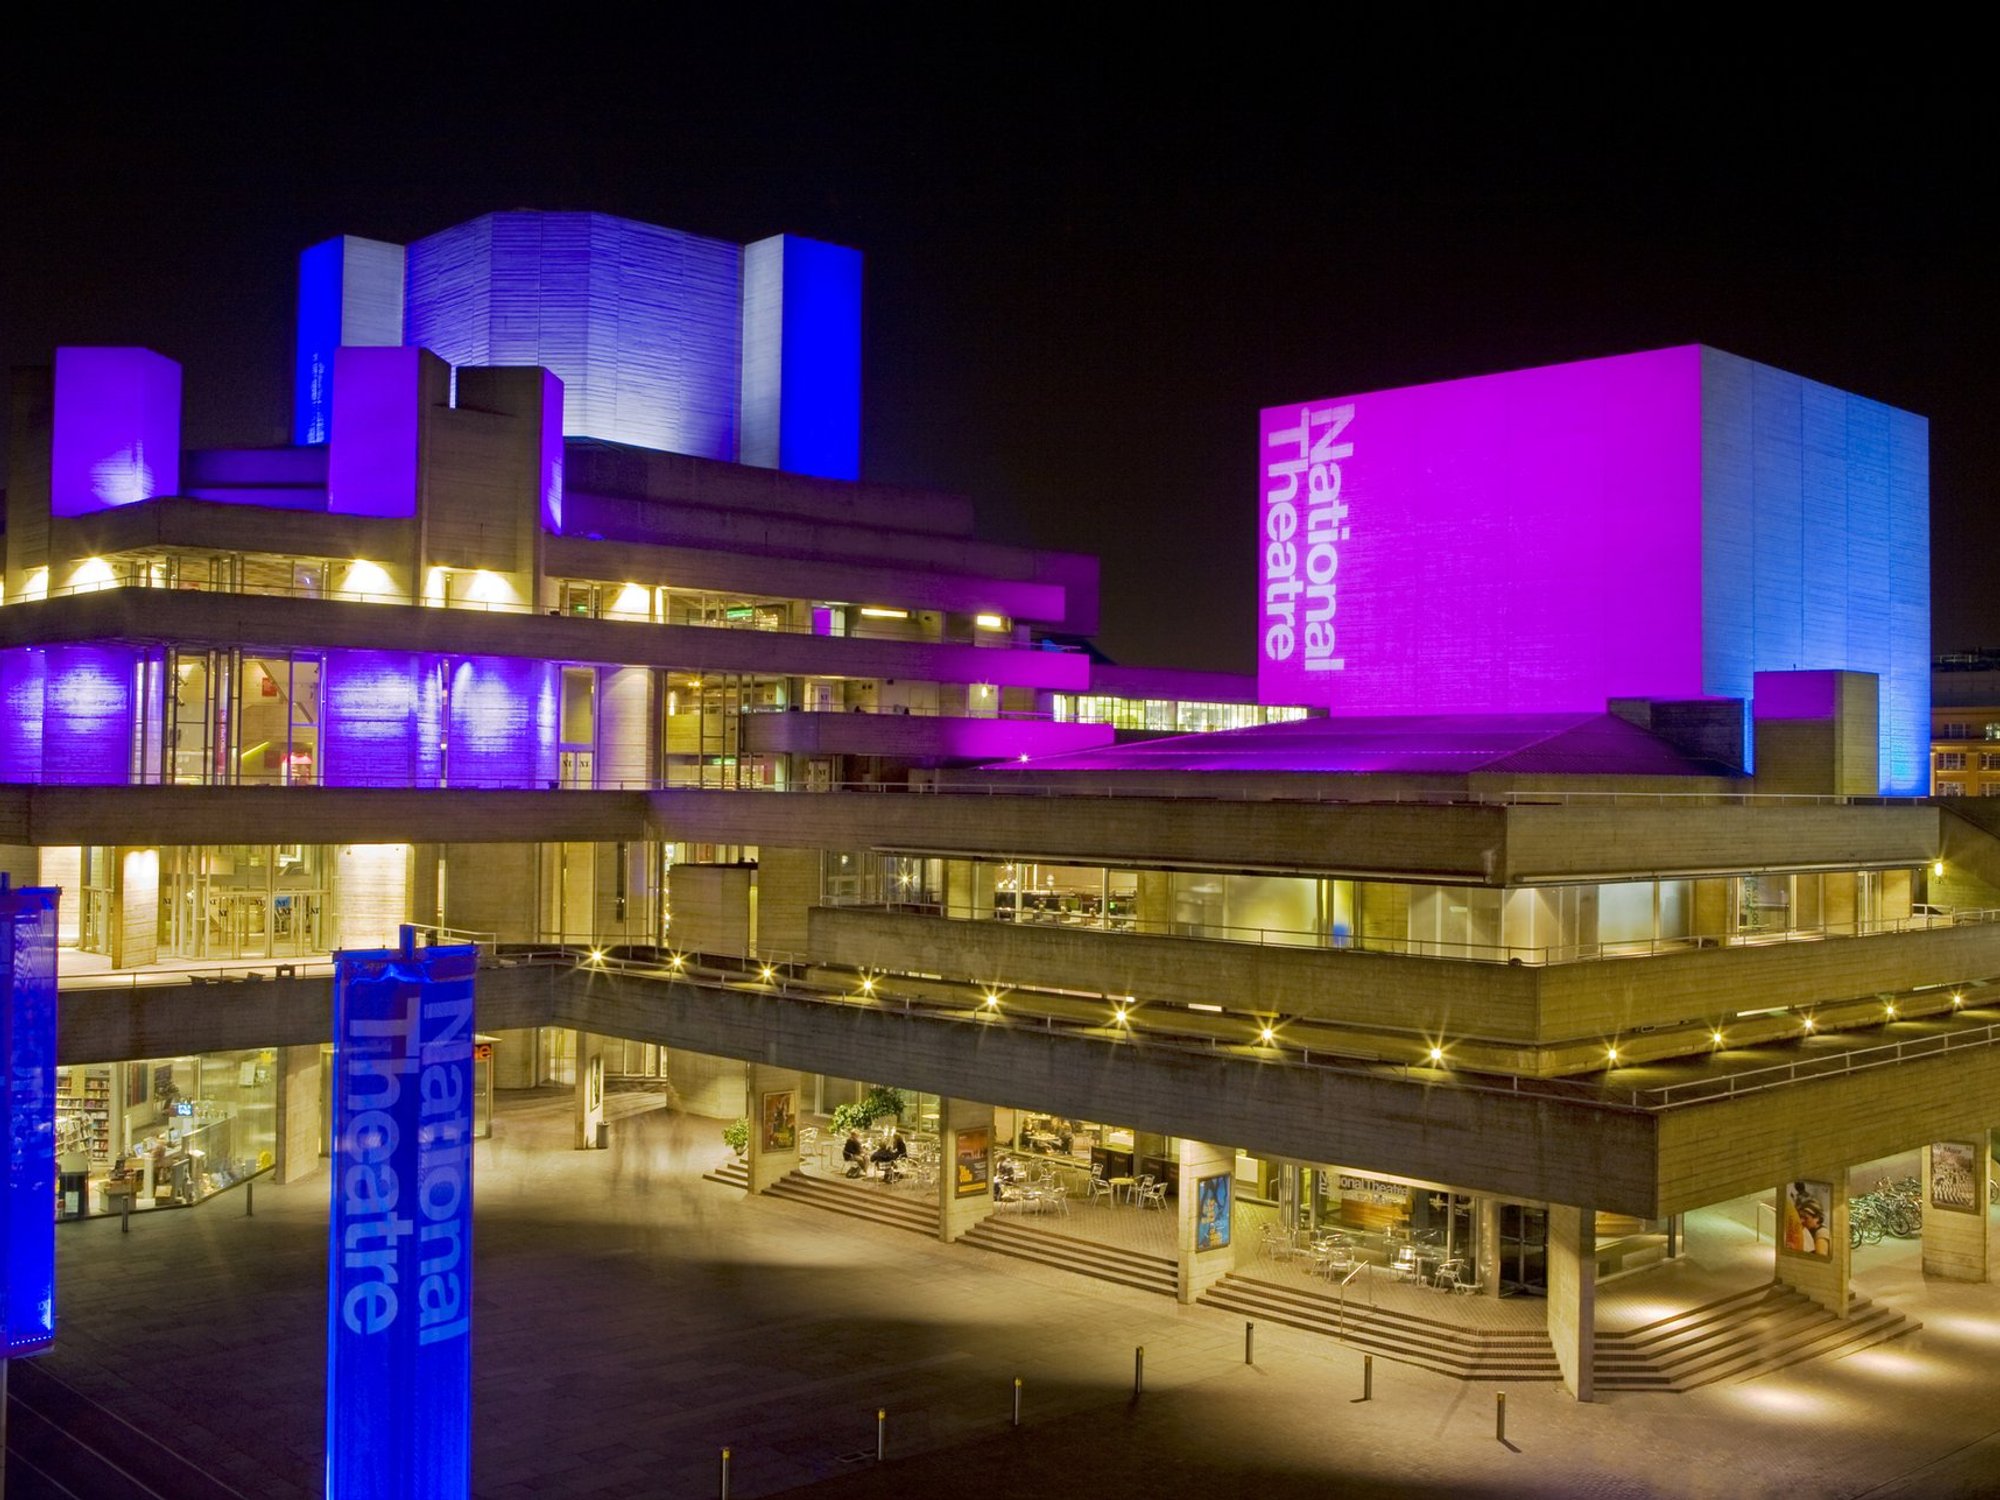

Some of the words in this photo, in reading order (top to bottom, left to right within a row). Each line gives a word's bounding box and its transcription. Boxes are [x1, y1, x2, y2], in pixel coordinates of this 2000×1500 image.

[1265, 406, 1310, 661] Theatre
[1304, 402, 1355, 672] National
[343, 997, 420, 1336] Theatre
[418, 997, 473, 1346] National
[1365, 1179, 1409, 1197] Theatre
